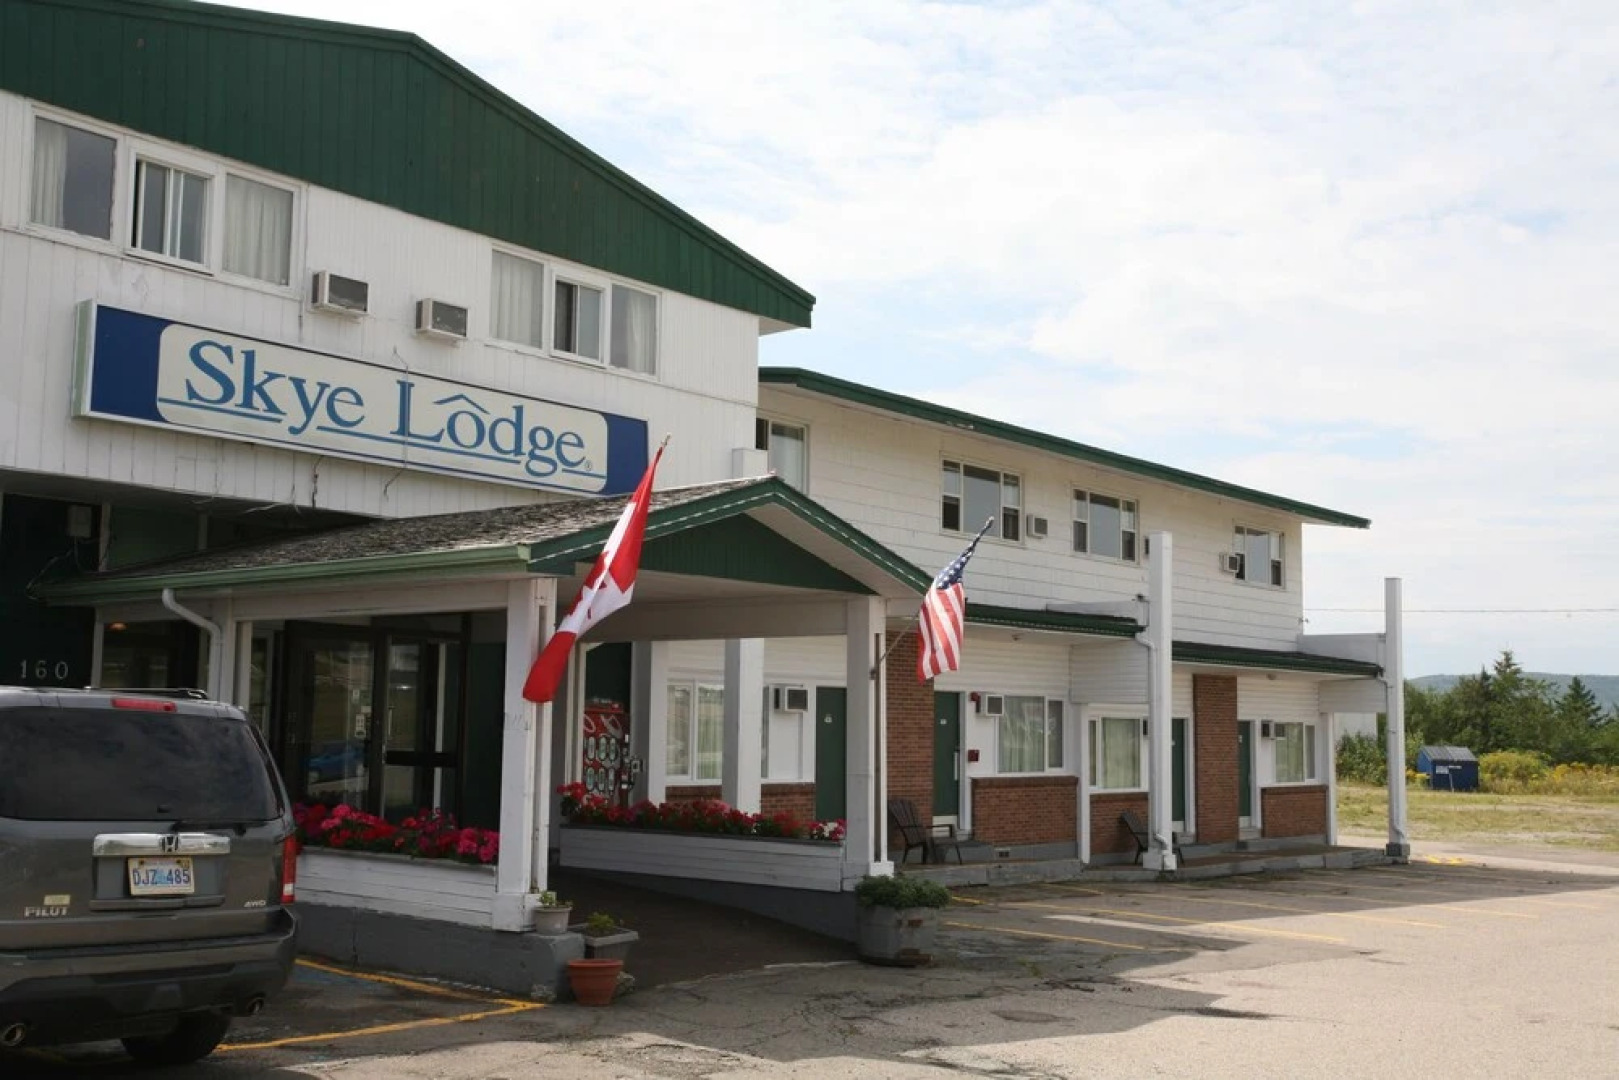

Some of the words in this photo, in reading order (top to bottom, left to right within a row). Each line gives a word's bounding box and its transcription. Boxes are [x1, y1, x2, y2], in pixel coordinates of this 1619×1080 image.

[186, 340, 366, 435] Skye
[20, 659, 69, 679] 160
[166, 868, 191, 885] 485
[24, 906, 68, 917] PILOT
